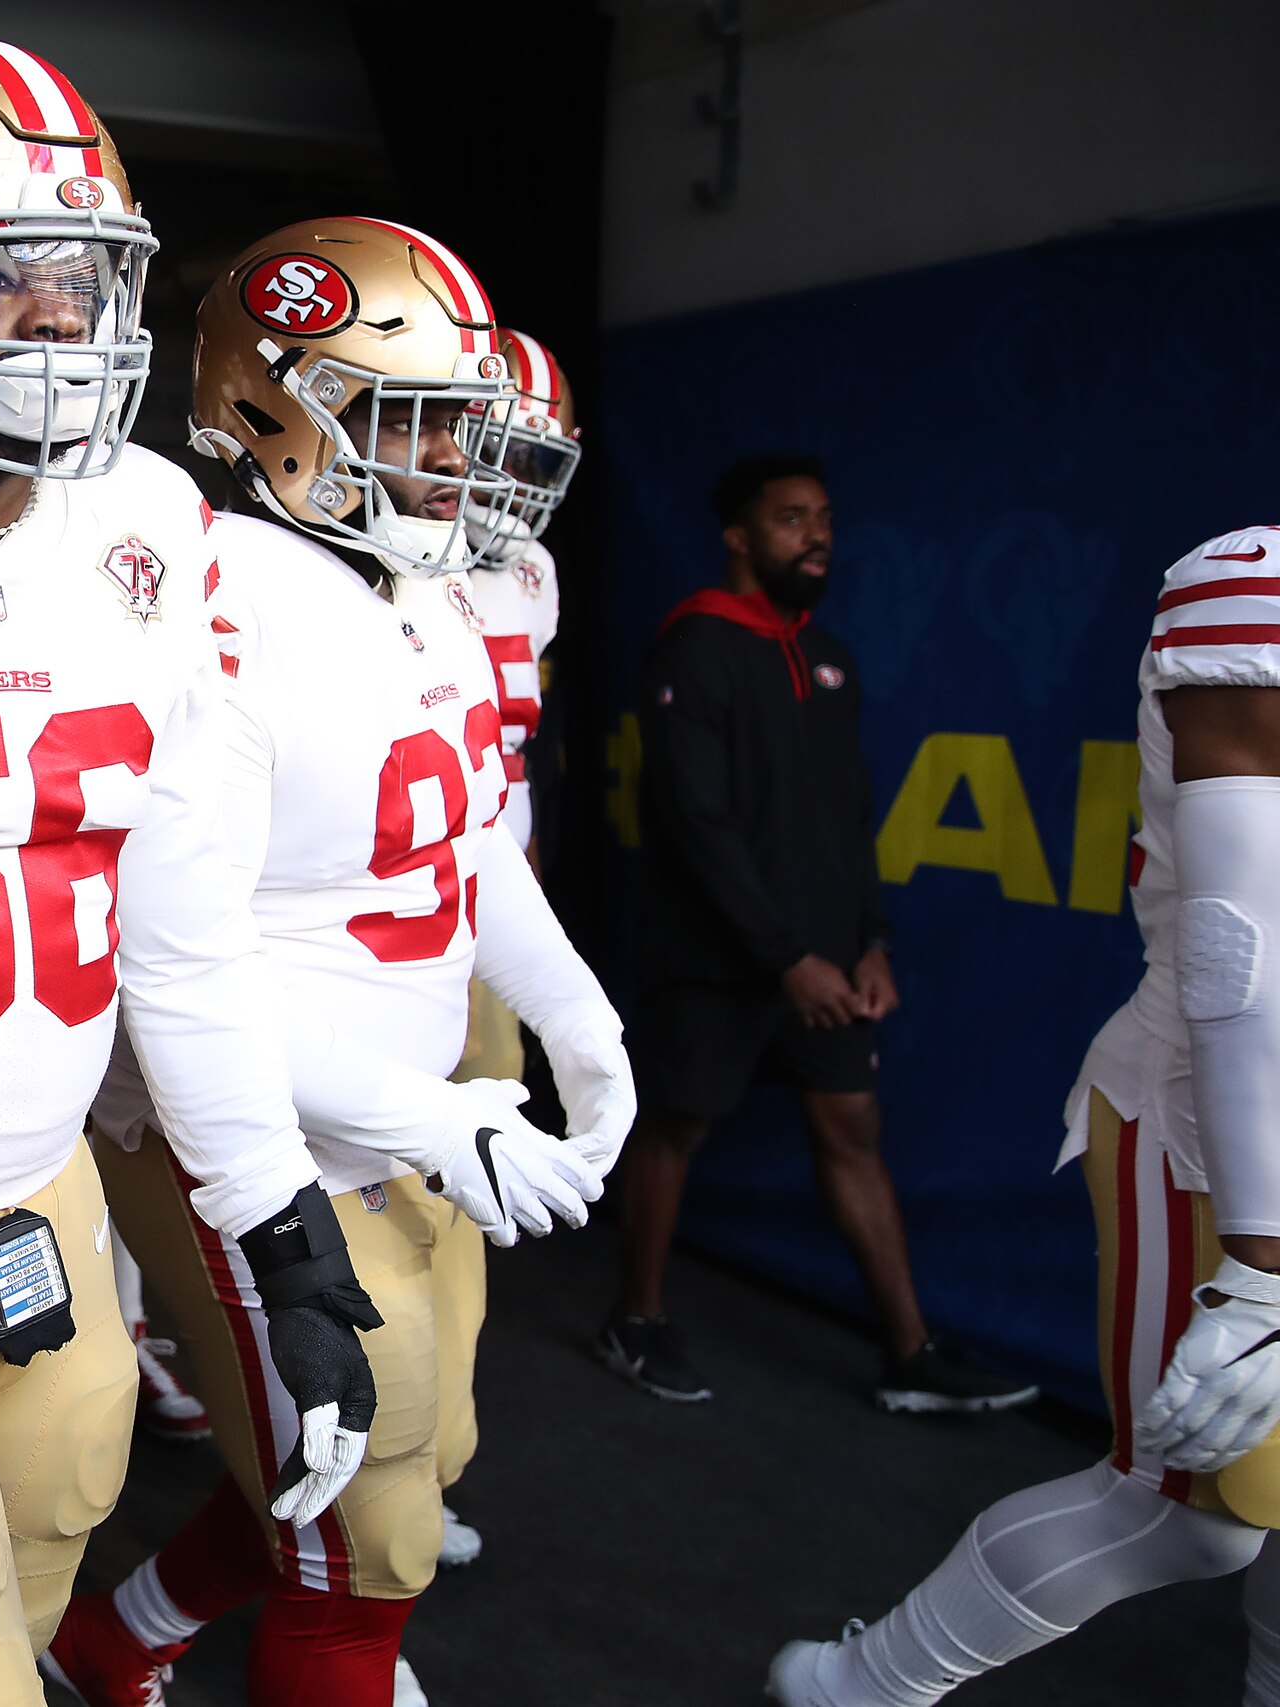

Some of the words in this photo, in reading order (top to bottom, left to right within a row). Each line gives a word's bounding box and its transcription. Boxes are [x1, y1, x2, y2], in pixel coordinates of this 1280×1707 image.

[420, 682, 461, 709] 49ERS
[19, 1252, 41, 1264] OUTLAW
[5, 1272, 23, 1283] CHECK
[26, 1270, 47, 1283] OUTLAW
